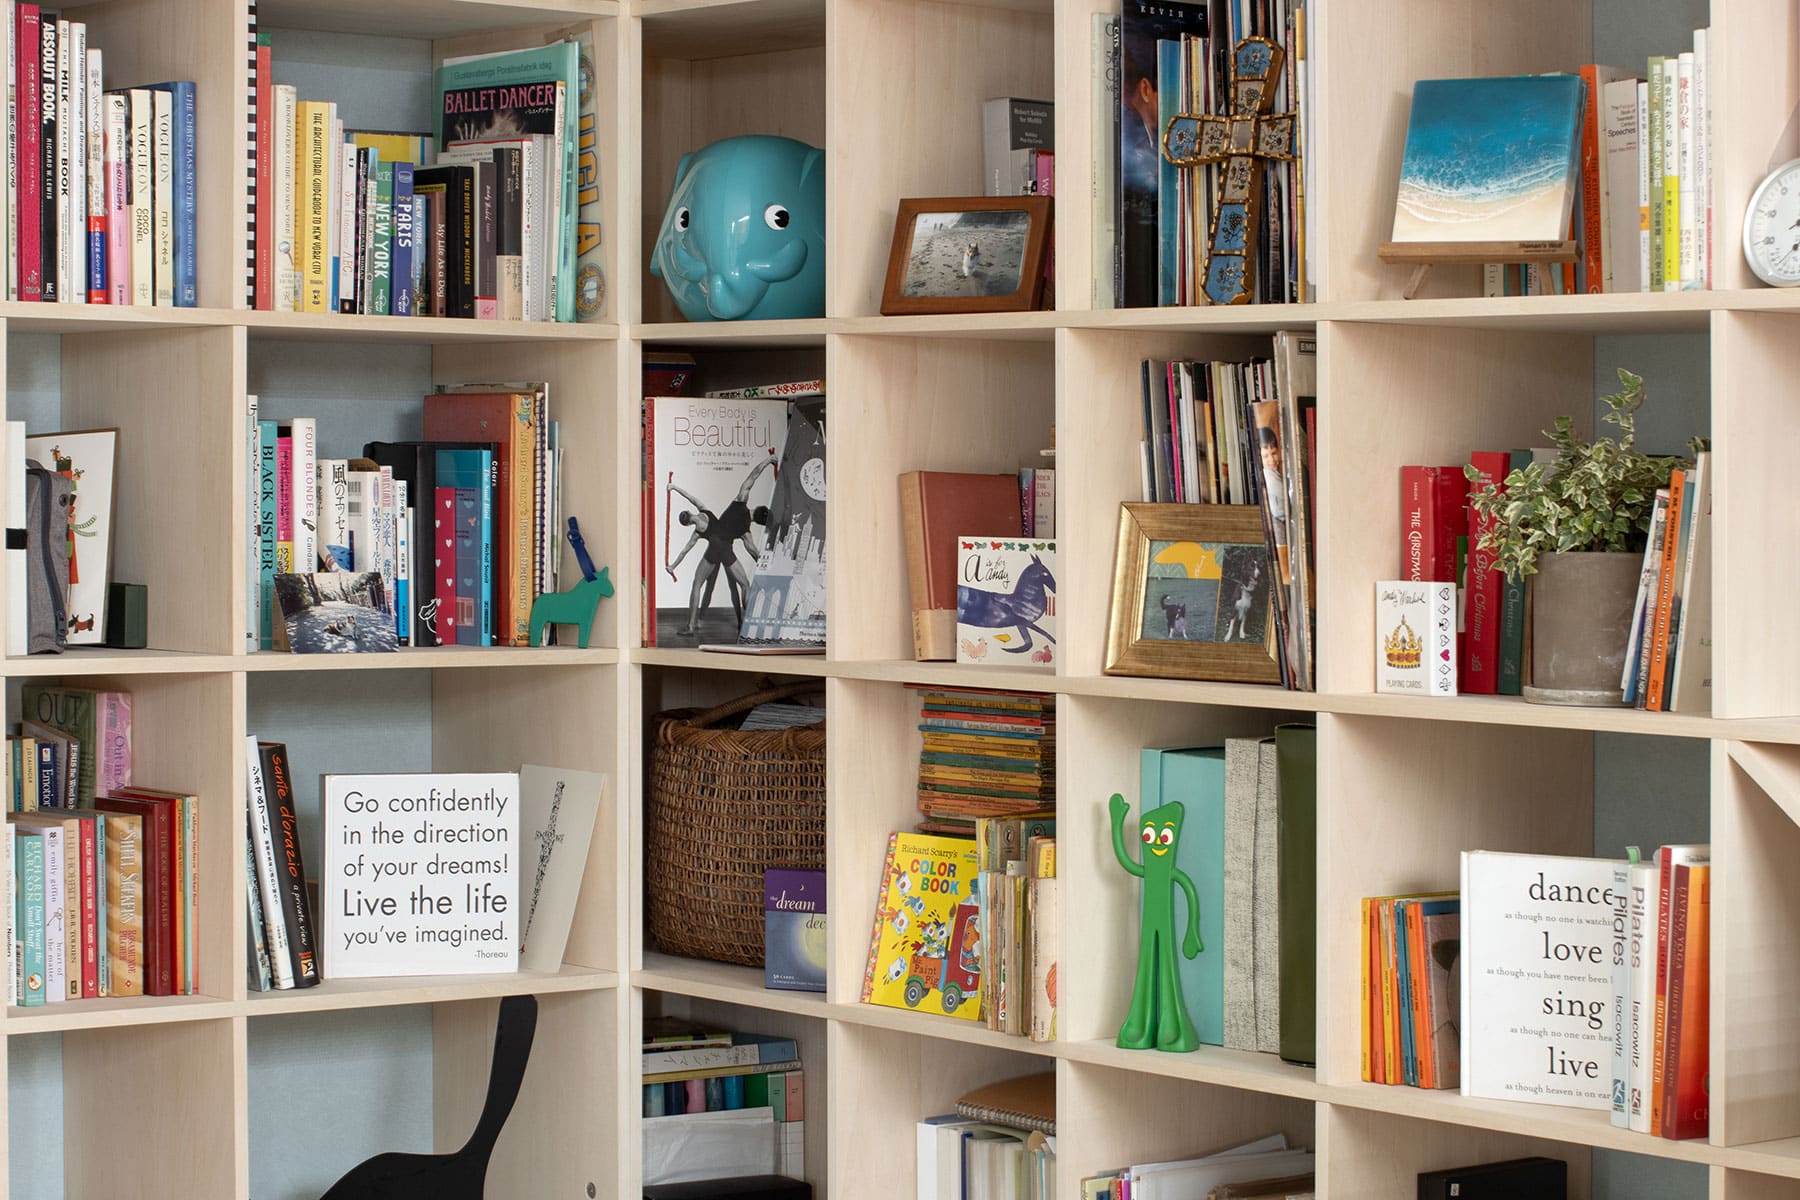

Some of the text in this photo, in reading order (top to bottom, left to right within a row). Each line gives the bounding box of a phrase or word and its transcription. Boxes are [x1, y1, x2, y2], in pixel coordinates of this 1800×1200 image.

[43, 23, 55, 80] ABSOLUT
[43, 83, 55, 124] BOOK.
[445, 84, 554, 113] BALLET DANCER
[312, 113, 322, 125] THE
[1608, 127, 1636, 138] Speeches
[137, 124, 147, 194] VOGUE ON
[159, 113, 169, 183] VOGUE ON
[312, 127, 322, 176] ARCHITECTURAL
[374, 203, 389, 279] NEW YORK
[397, 204, 412, 248] PARIS
[436, 223, 445, 298] My Life As Dog
[689, 405, 757, 420] Every Body is
[674, 417, 772, 448] Beautiful
[262, 445, 274, 503] BLACK
[305, 426, 315, 572] FOUR BLONDES Candace
[1410, 507, 1421, 528] THE
[262, 511, 274, 570] SISTER
[1666, 510, 1678, 561] FORSTER
[1474, 554, 1489, 641] Before Christmas
[1505, 585, 1519, 638] Christmas
[1386, 679, 1422, 689] PLAYING CARDS
[37, 692, 81, 726] OUT
[113, 735, 124, 775] Out in
[344, 789, 508, 817] Go confidently
[67, 829, 76, 849] THE
[271, 753, 308, 946] sante d'orazio private view
[343, 821, 508, 844] in the direction
[343, 853, 508, 882] of your dreams!
[901, 844, 959, 859] Richard Scarry's
[910, 858, 957, 878] COLOR
[25, 841, 34, 901] CARLSON
[33, 841, 42, 902] RICHARD
[49, 851, 57, 903] emily giffin
[67, 857, 76, 901] HOBBIT
[119, 831, 137, 924] SHELL SEEKERS
[920, 877, 959, 895] BOOK
[343, 883, 507, 916] Live the life
[775, 890, 815, 911] dream
[1529, 872, 1613, 906] dance
[27, 905, 35, 928] Small
[805, 913, 826, 929] dec
[1513, 911, 1543, 922] though
[1575, 915, 1584, 923] is
[1659, 887, 1671, 943] PILATES
[1679, 886, 1687, 927] LIVING
[34, 905, 42, 964] Don't Sweat the
[119, 930, 128, 961] PILCHER
[127, 930, 136, 973] ROSAMUNDE
[343, 923, 508, 949] you've imagined.
[1542, 931, 1603, 963] love
[1677, 933, 1685, 970] YOGA
[57, 967, 63, 976] of
[474, 950, 508, 959] -Thoreau
[913, 963, 937, 976] Paint
[925, 975, 939, 988] Pig
[1496, 967, 1525, 979] though
[1526, 972, 1542, 981] you
[1544, 969, 1562, 980] have
[1564, 974, 1586, 982] never
[1587, 973, 1608, 984] been
[1612, 895, 1628, 1058] Pilates Isacowitz
[1631, 886, 1645, 1068] Pilates Isacowitz
[1542, 990, 1605, 1030] sing
[1655, 1000, 1663, 1047] BROOKE
[1518, 1026, 1548, 1038] though
[1598, 1031, 1613, 1042] hea
[1546, 1046, 1599, 1079] live
[1513, 1082, 1543, 1094] though
[1545, 1086, 1573, 1096] heaven
[1575, 1089, 1583, 1097] is
